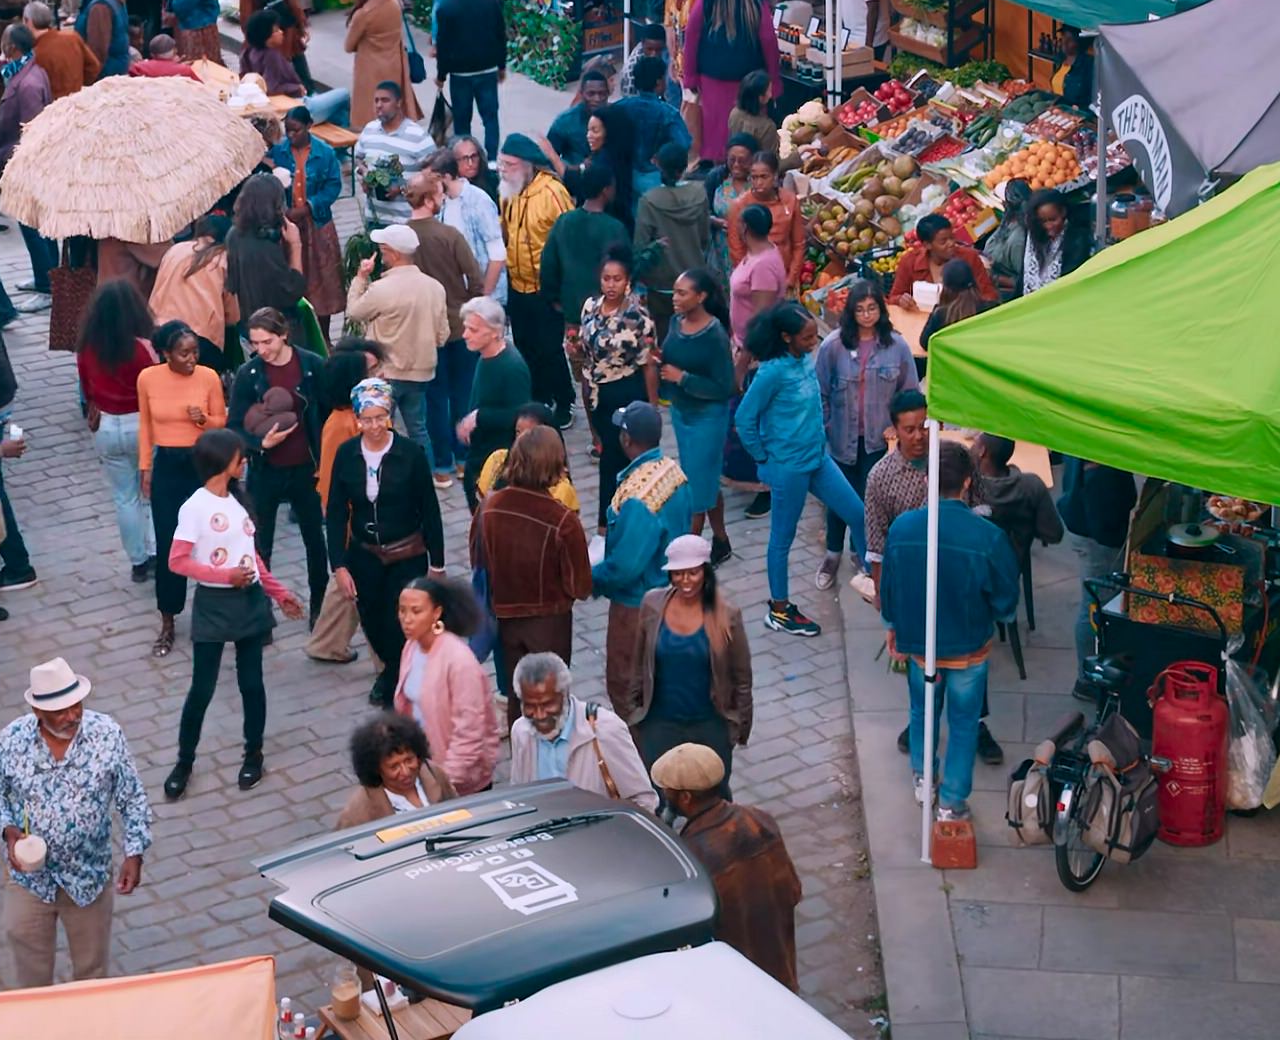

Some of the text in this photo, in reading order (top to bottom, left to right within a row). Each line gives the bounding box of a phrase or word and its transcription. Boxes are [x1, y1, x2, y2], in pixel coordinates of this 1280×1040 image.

[1118, 102, 1169, 200] THE RIB MAN
[404, 831, 554, 880] BeatsandGrind
